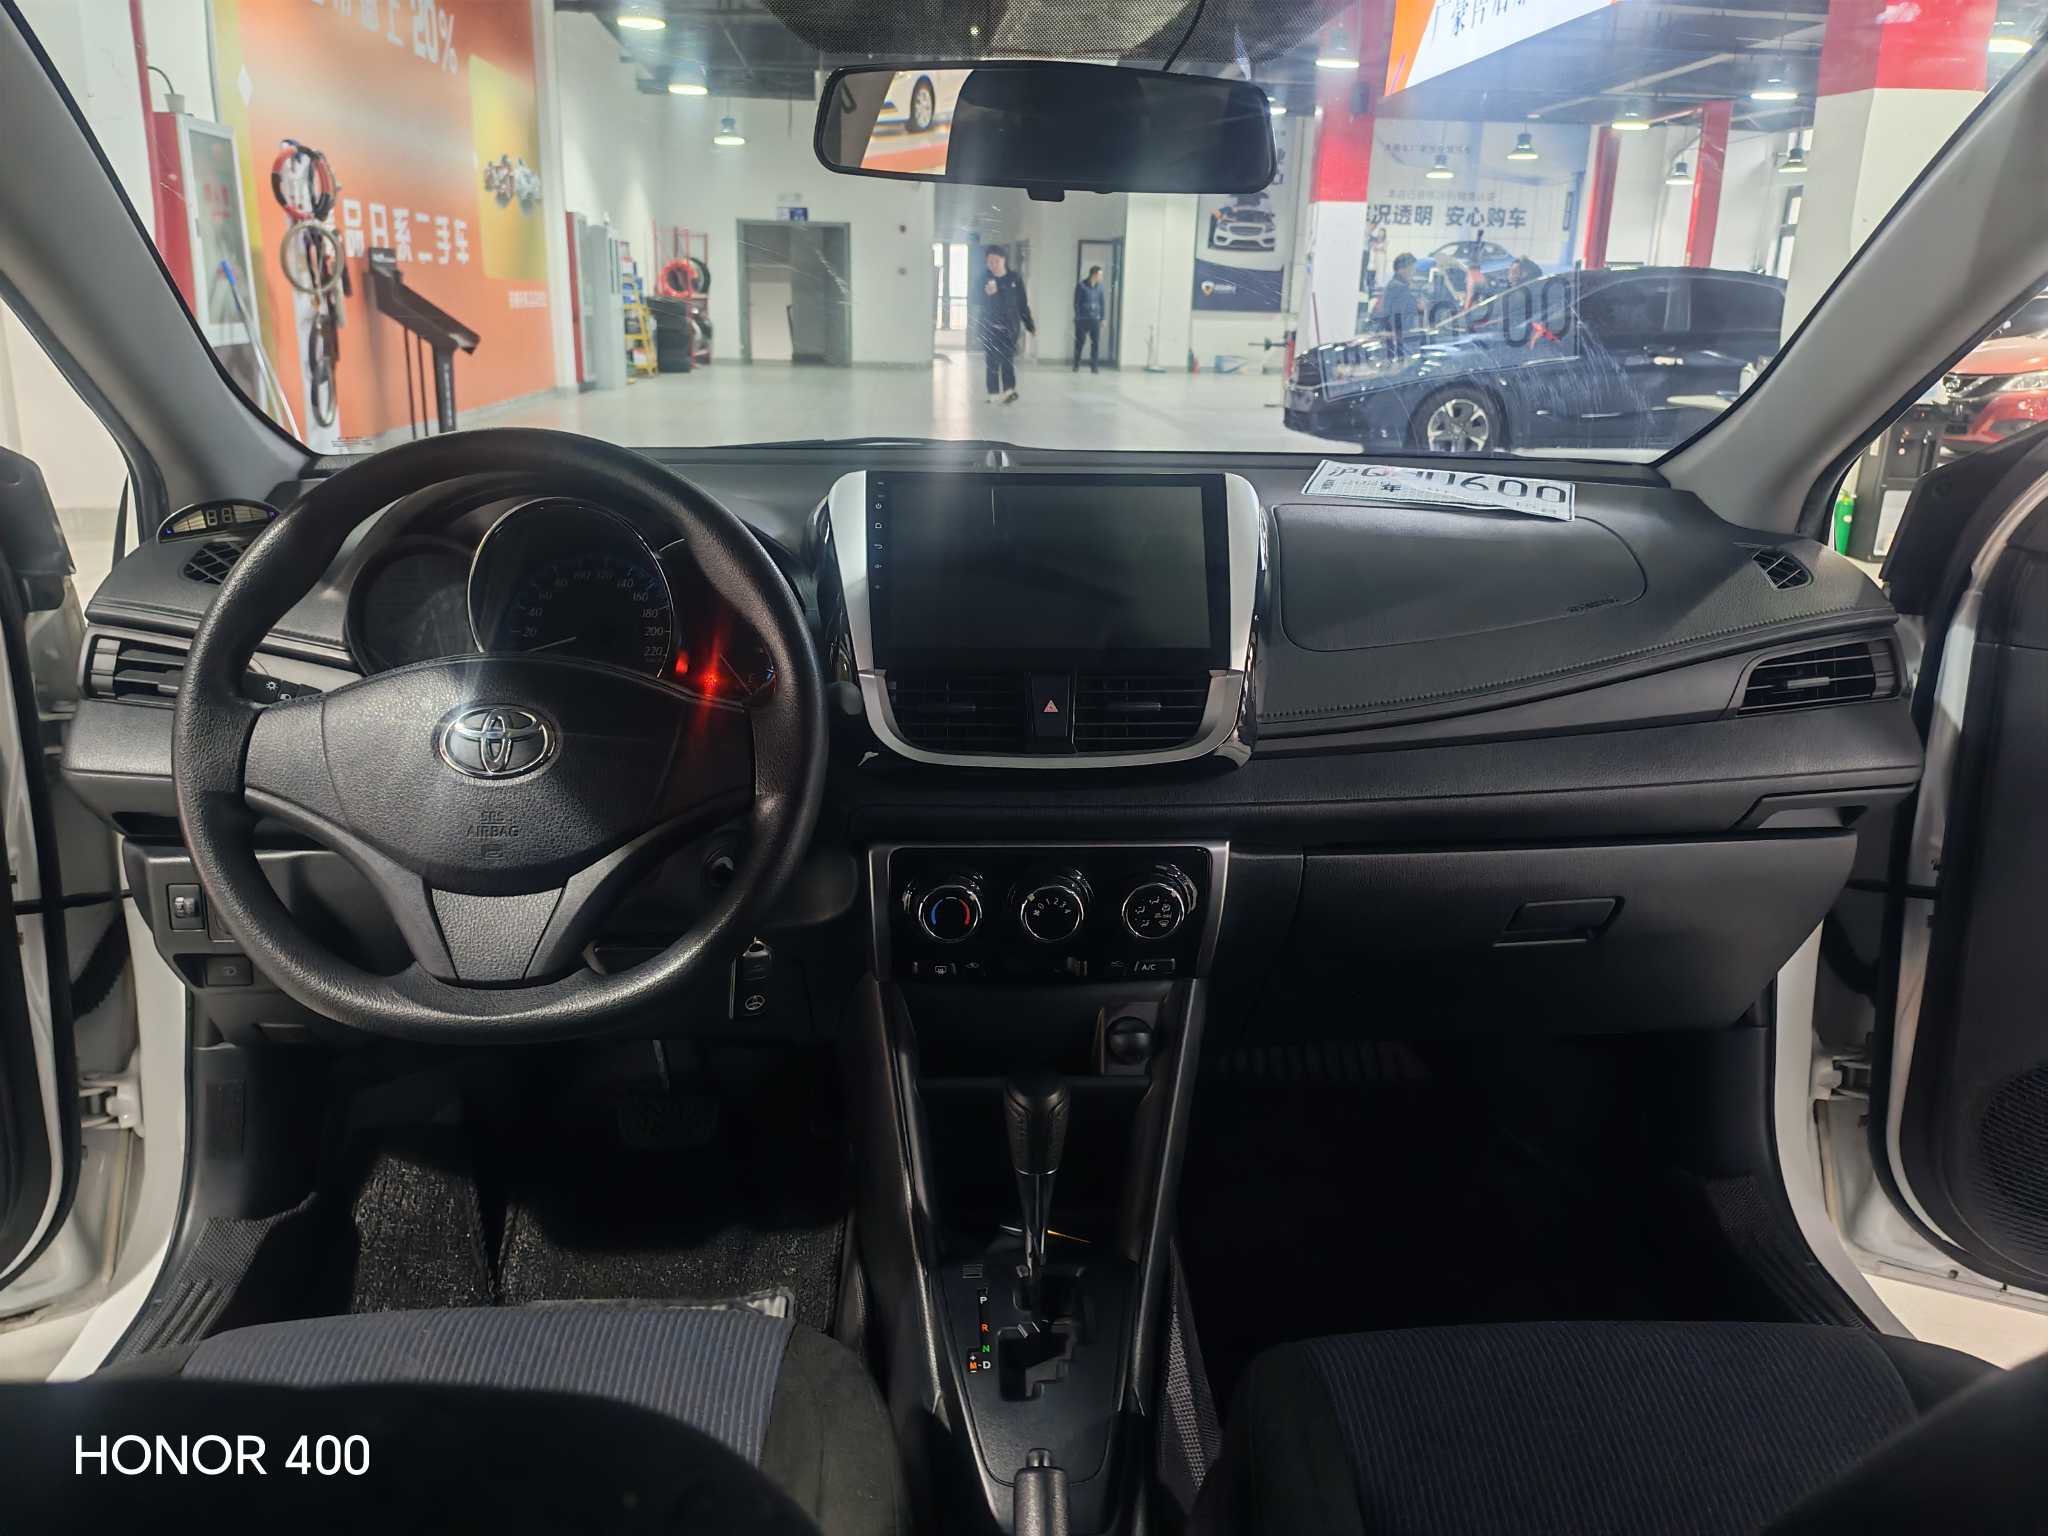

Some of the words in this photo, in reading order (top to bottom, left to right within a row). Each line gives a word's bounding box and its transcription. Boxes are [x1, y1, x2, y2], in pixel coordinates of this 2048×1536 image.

[1445, 205, 1528, 229] 安心购车
[641, 607, 659, 619] 180
[644, 625, 664, 637] 200
[466, 825, 519, 838] AIRBAG
[979, 1296, 988, 1304] P
[981, 1323, 990, 1332] R
